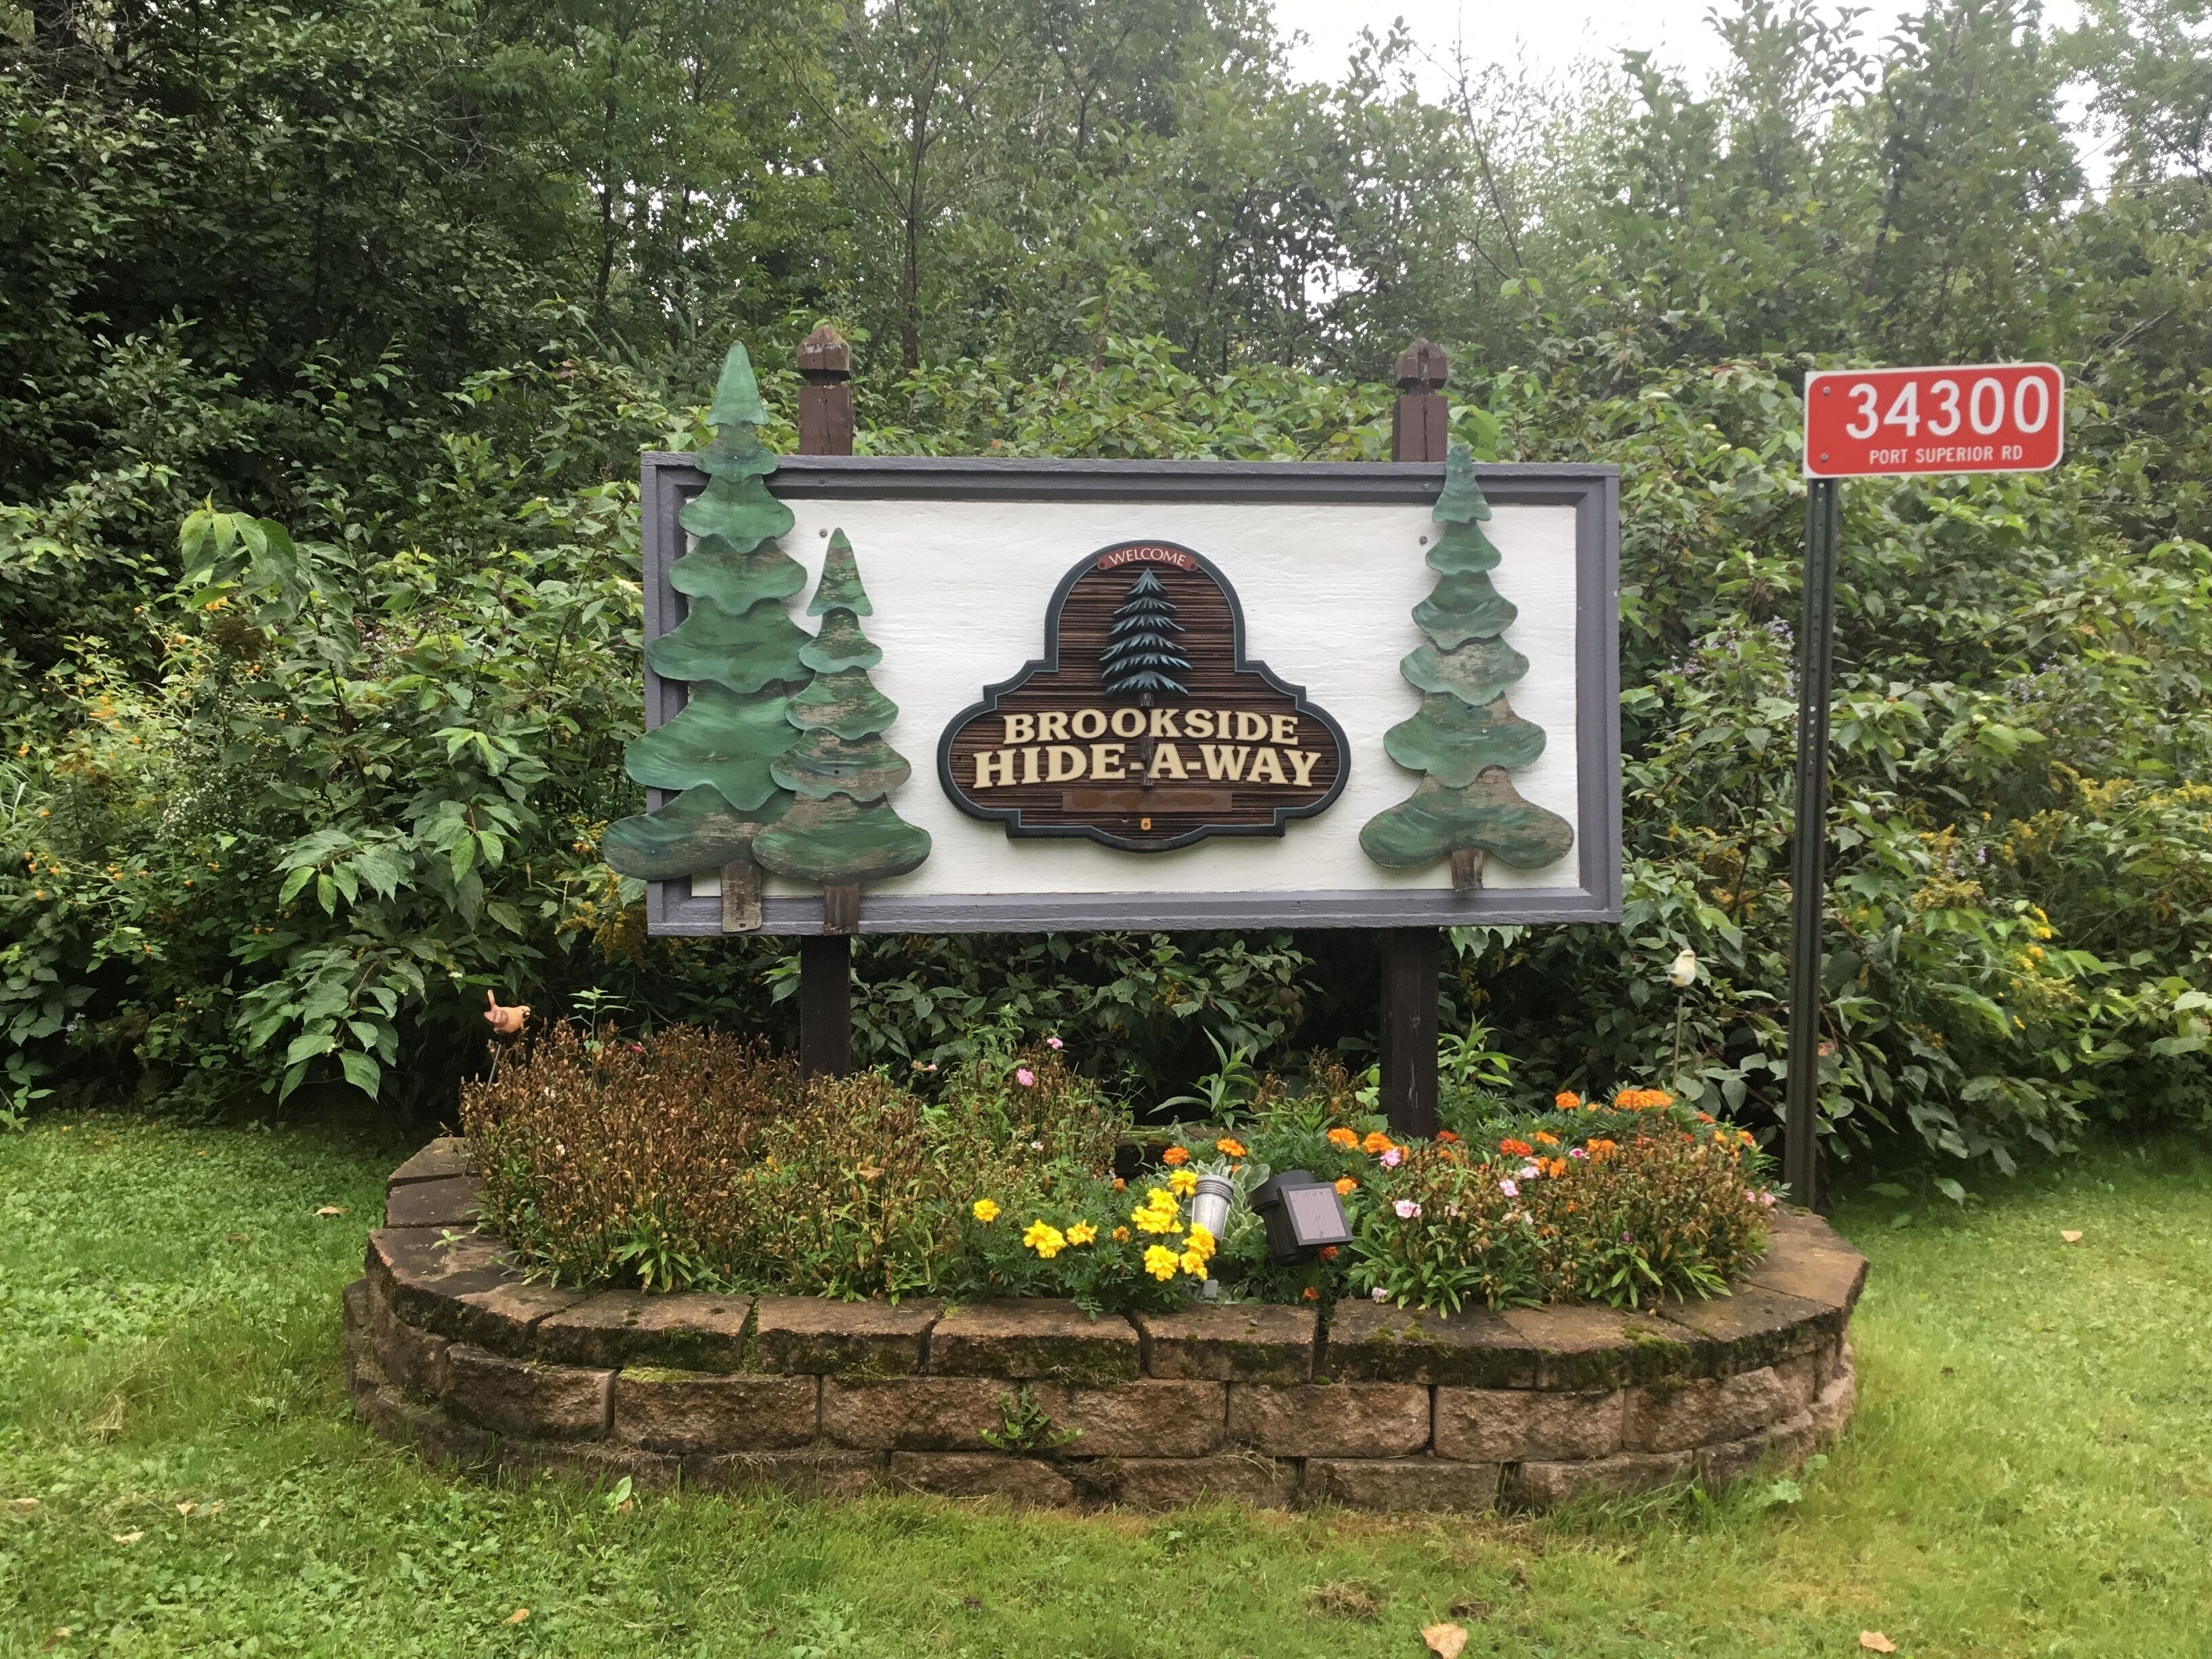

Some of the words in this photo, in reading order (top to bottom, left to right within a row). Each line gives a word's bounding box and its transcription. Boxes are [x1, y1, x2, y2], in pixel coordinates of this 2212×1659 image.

[1846, 375, 2049, 439] 34300
[1869, 449, 1908, 464] PORT
[1915, 446, 1994, 464] SUPERIOR
[2001, 445, 2023, 461] RD
[1109, 548, 1187, 567] WELCOME
[1003, 708, 1299, 745] BROOKSIDE
[973, 743, 1322, 790] HIDE-A-WAY
